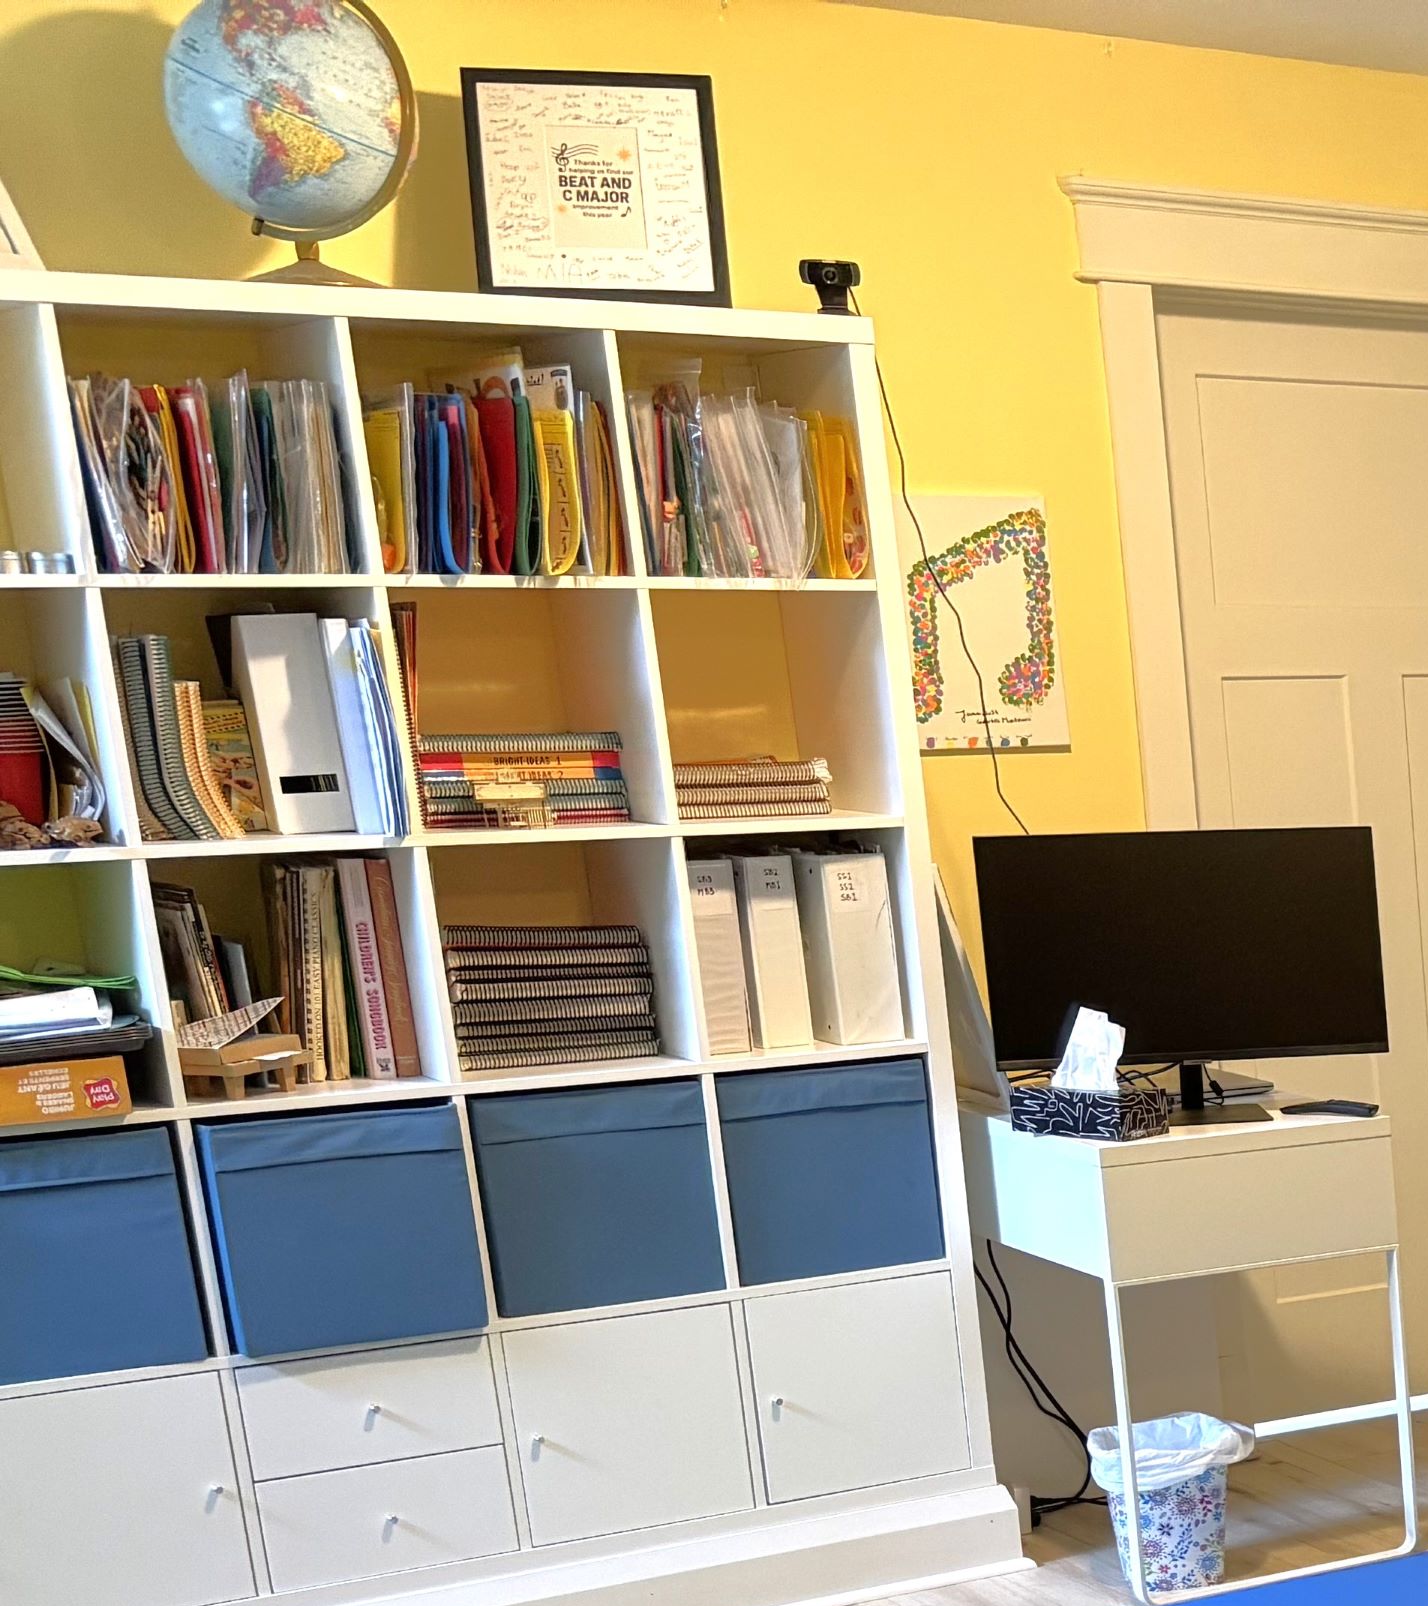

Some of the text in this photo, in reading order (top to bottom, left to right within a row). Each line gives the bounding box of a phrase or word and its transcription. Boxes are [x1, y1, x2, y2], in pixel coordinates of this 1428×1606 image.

[558, 175, 632, 189] BEAT AND
[562, 189, 630, 203] C MAJOR
[493, 756, 524, 766] BRIGHT
[526, 756, 550, 766] IDEAS
[312, 966, 321, 990] EASY
[355, 922, 387, 1050] CHILDREN'S SONGBOOK
[314, 1022, 324, 1060] HOOKED
[17, 1081, 71, 1094] JEU GÉANT
[90, 1084, 111, 1094] Day
[92, 1092, 115, 1103] Play
[41, 1103, 76, 1114] JUMBO
